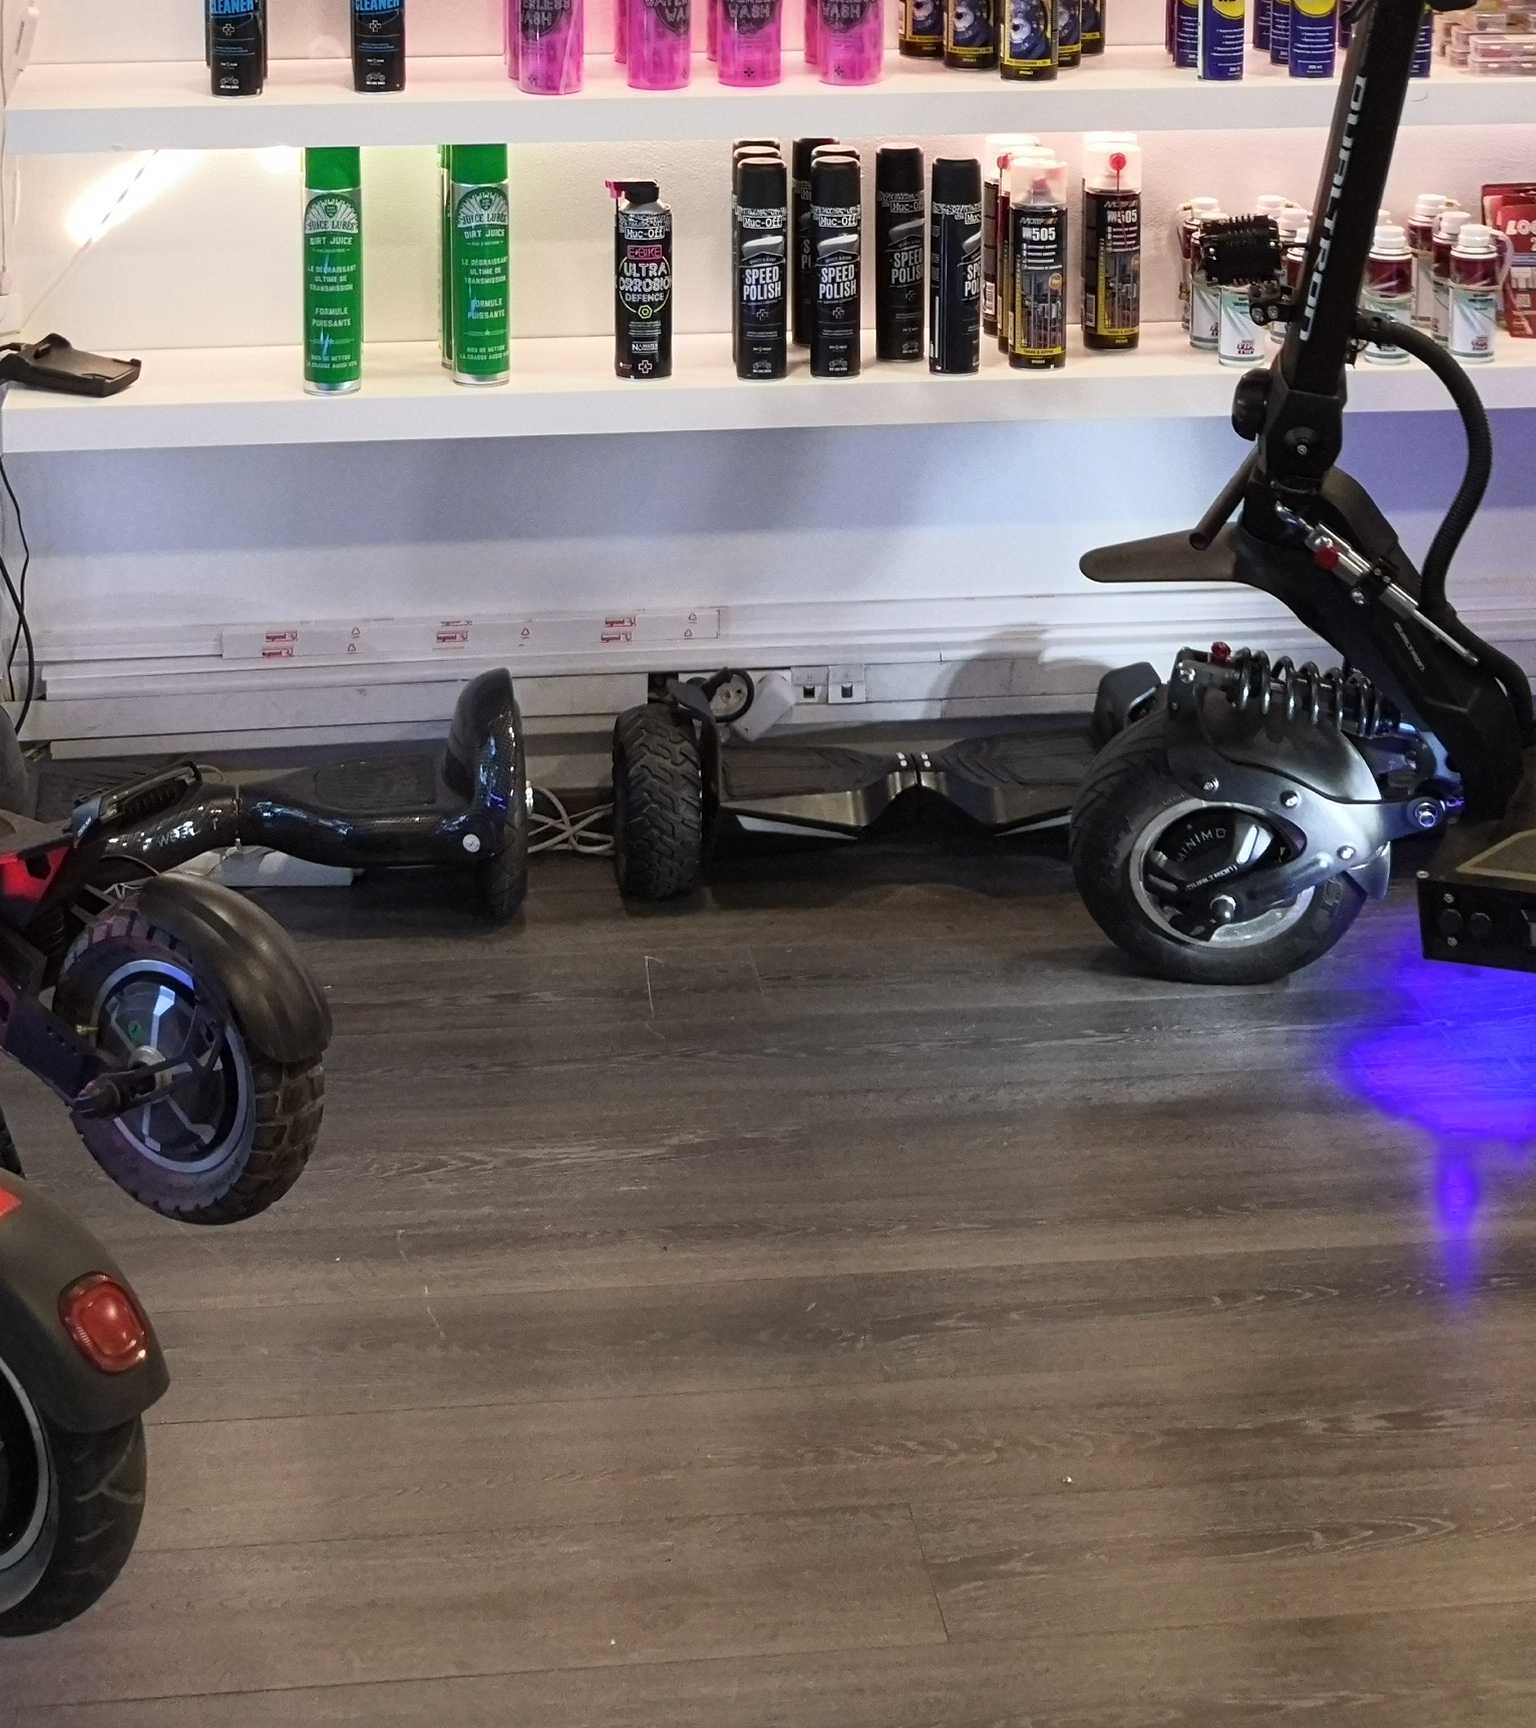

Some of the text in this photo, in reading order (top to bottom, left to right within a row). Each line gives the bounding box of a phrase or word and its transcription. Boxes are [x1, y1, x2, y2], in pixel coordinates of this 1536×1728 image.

[1300, 75, 1367, 342] DUALTRON
[744, 215, 782, 229] Muc-Off
[820, 214, 856, 228] Muc-Off
[330, 236, 353, 246] JUICE
[624, 262, 668, 277] ULTRA
[745, 266, 780, 285] SPEED
[821, 264, 855, 284] SPEED
[625, 292, 665, 302] DEFENCE
[743, 282, 782, 301] POLISH
[819, 280, 857, 300] POLISH
